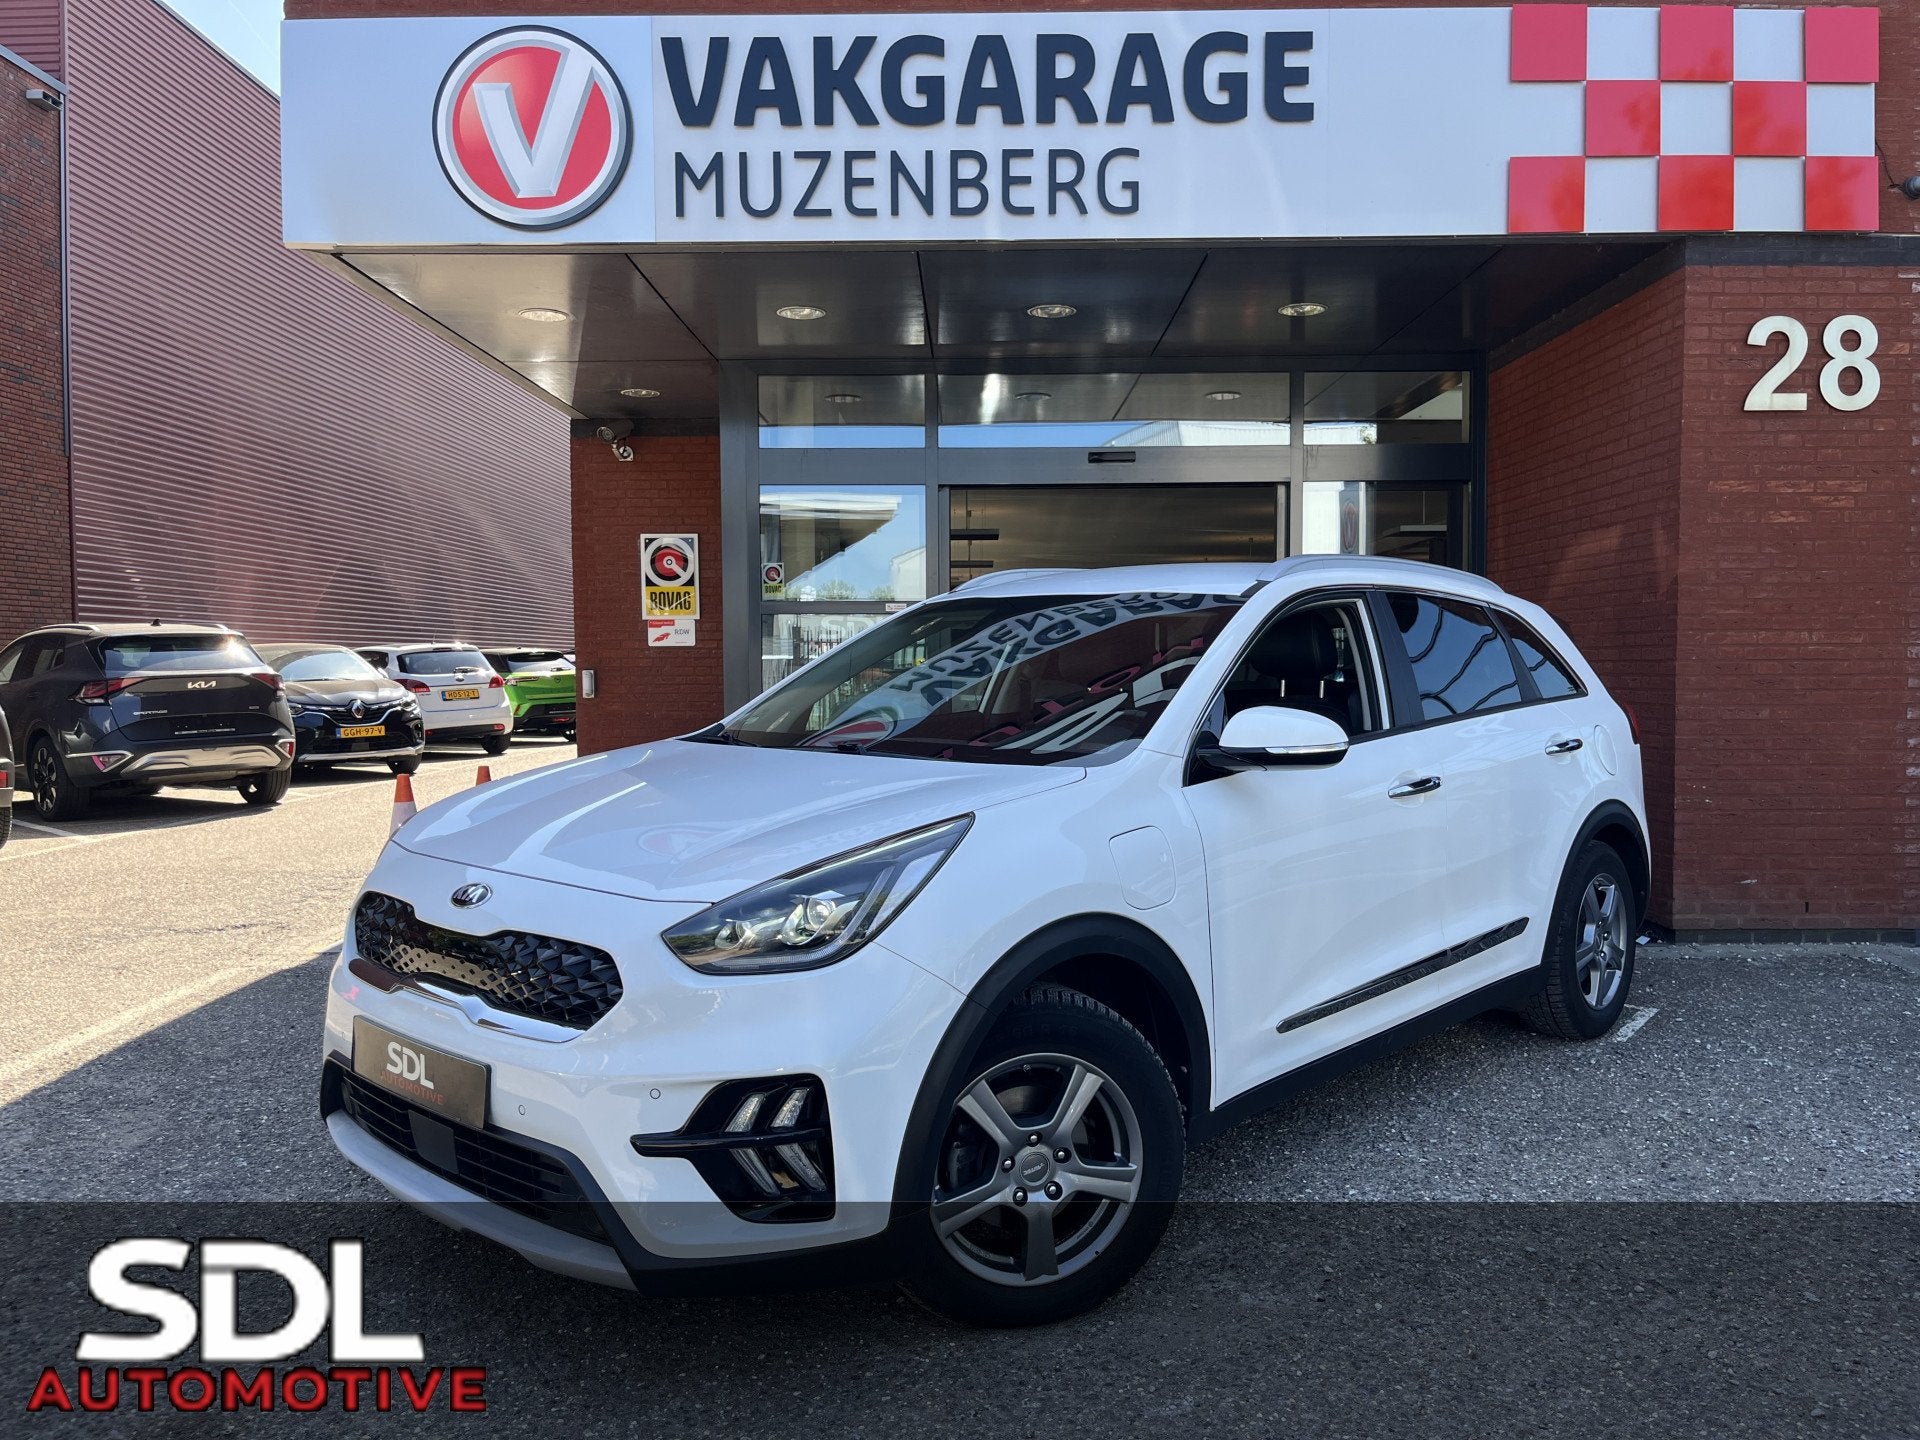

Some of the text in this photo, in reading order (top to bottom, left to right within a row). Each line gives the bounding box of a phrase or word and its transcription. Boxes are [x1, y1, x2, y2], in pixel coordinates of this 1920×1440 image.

[660, 30, 1315, 127] VAKGARAGE
[673, 146, 1141, 219] MUZENBERG
[1743, 314, 1881, 411] 28
[649, 591, 692, 611] BOVAG
[764, 585, 782, 594] BOVAG
[187, 680, 217, 689] KIA
[343, 726, 383, 737] GGH-97-V
[386, 1041, 435, 1090] SDL
[380, 1070, 447, 1105] AUTOMOTIVE
